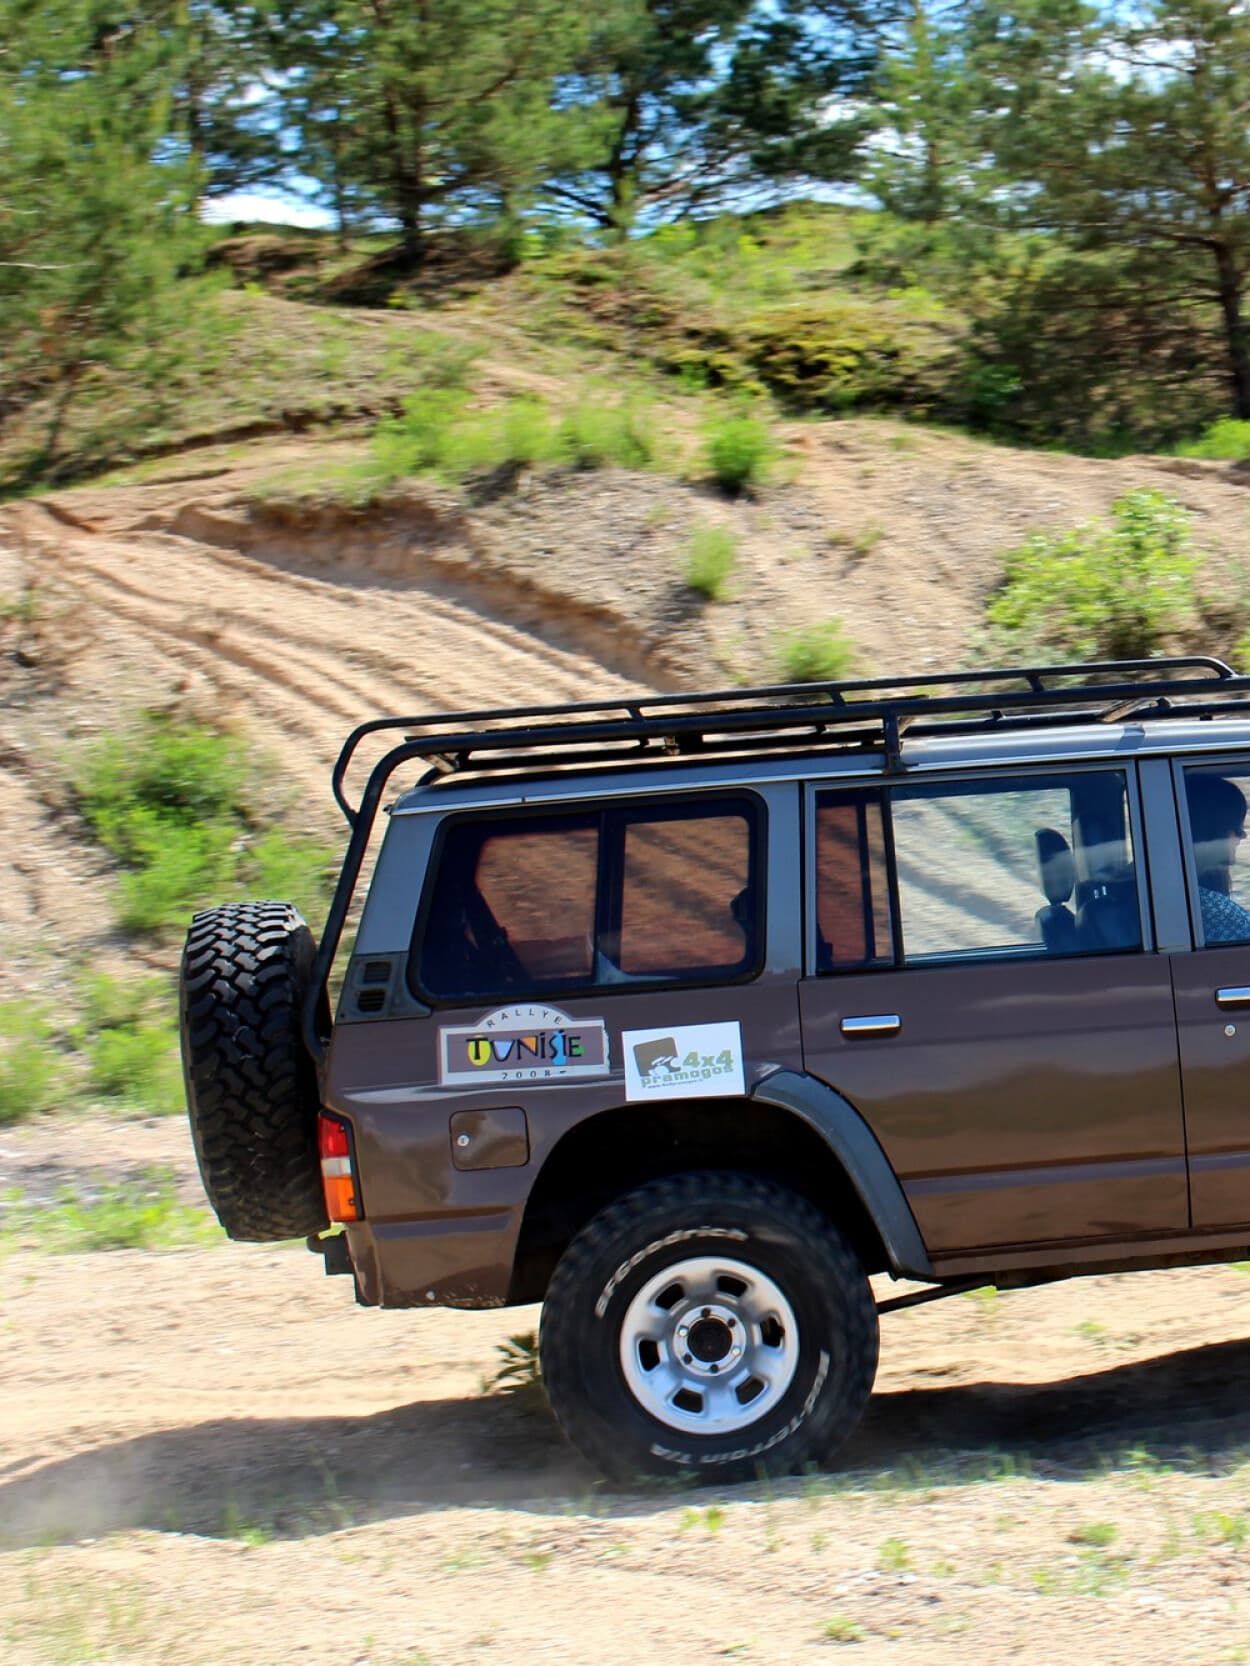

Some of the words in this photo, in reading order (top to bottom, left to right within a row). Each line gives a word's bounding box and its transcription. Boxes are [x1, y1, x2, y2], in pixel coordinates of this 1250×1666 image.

[486, 1008, 562, 1028] RALLYE
[466, 1030, 582, 1062] TUNISIE
[683, 1049, 734, 1068] 4x4
[641, 1065, 734, 1088] pramogos
[594, 1226, 748, 1318] BFGoodrich
